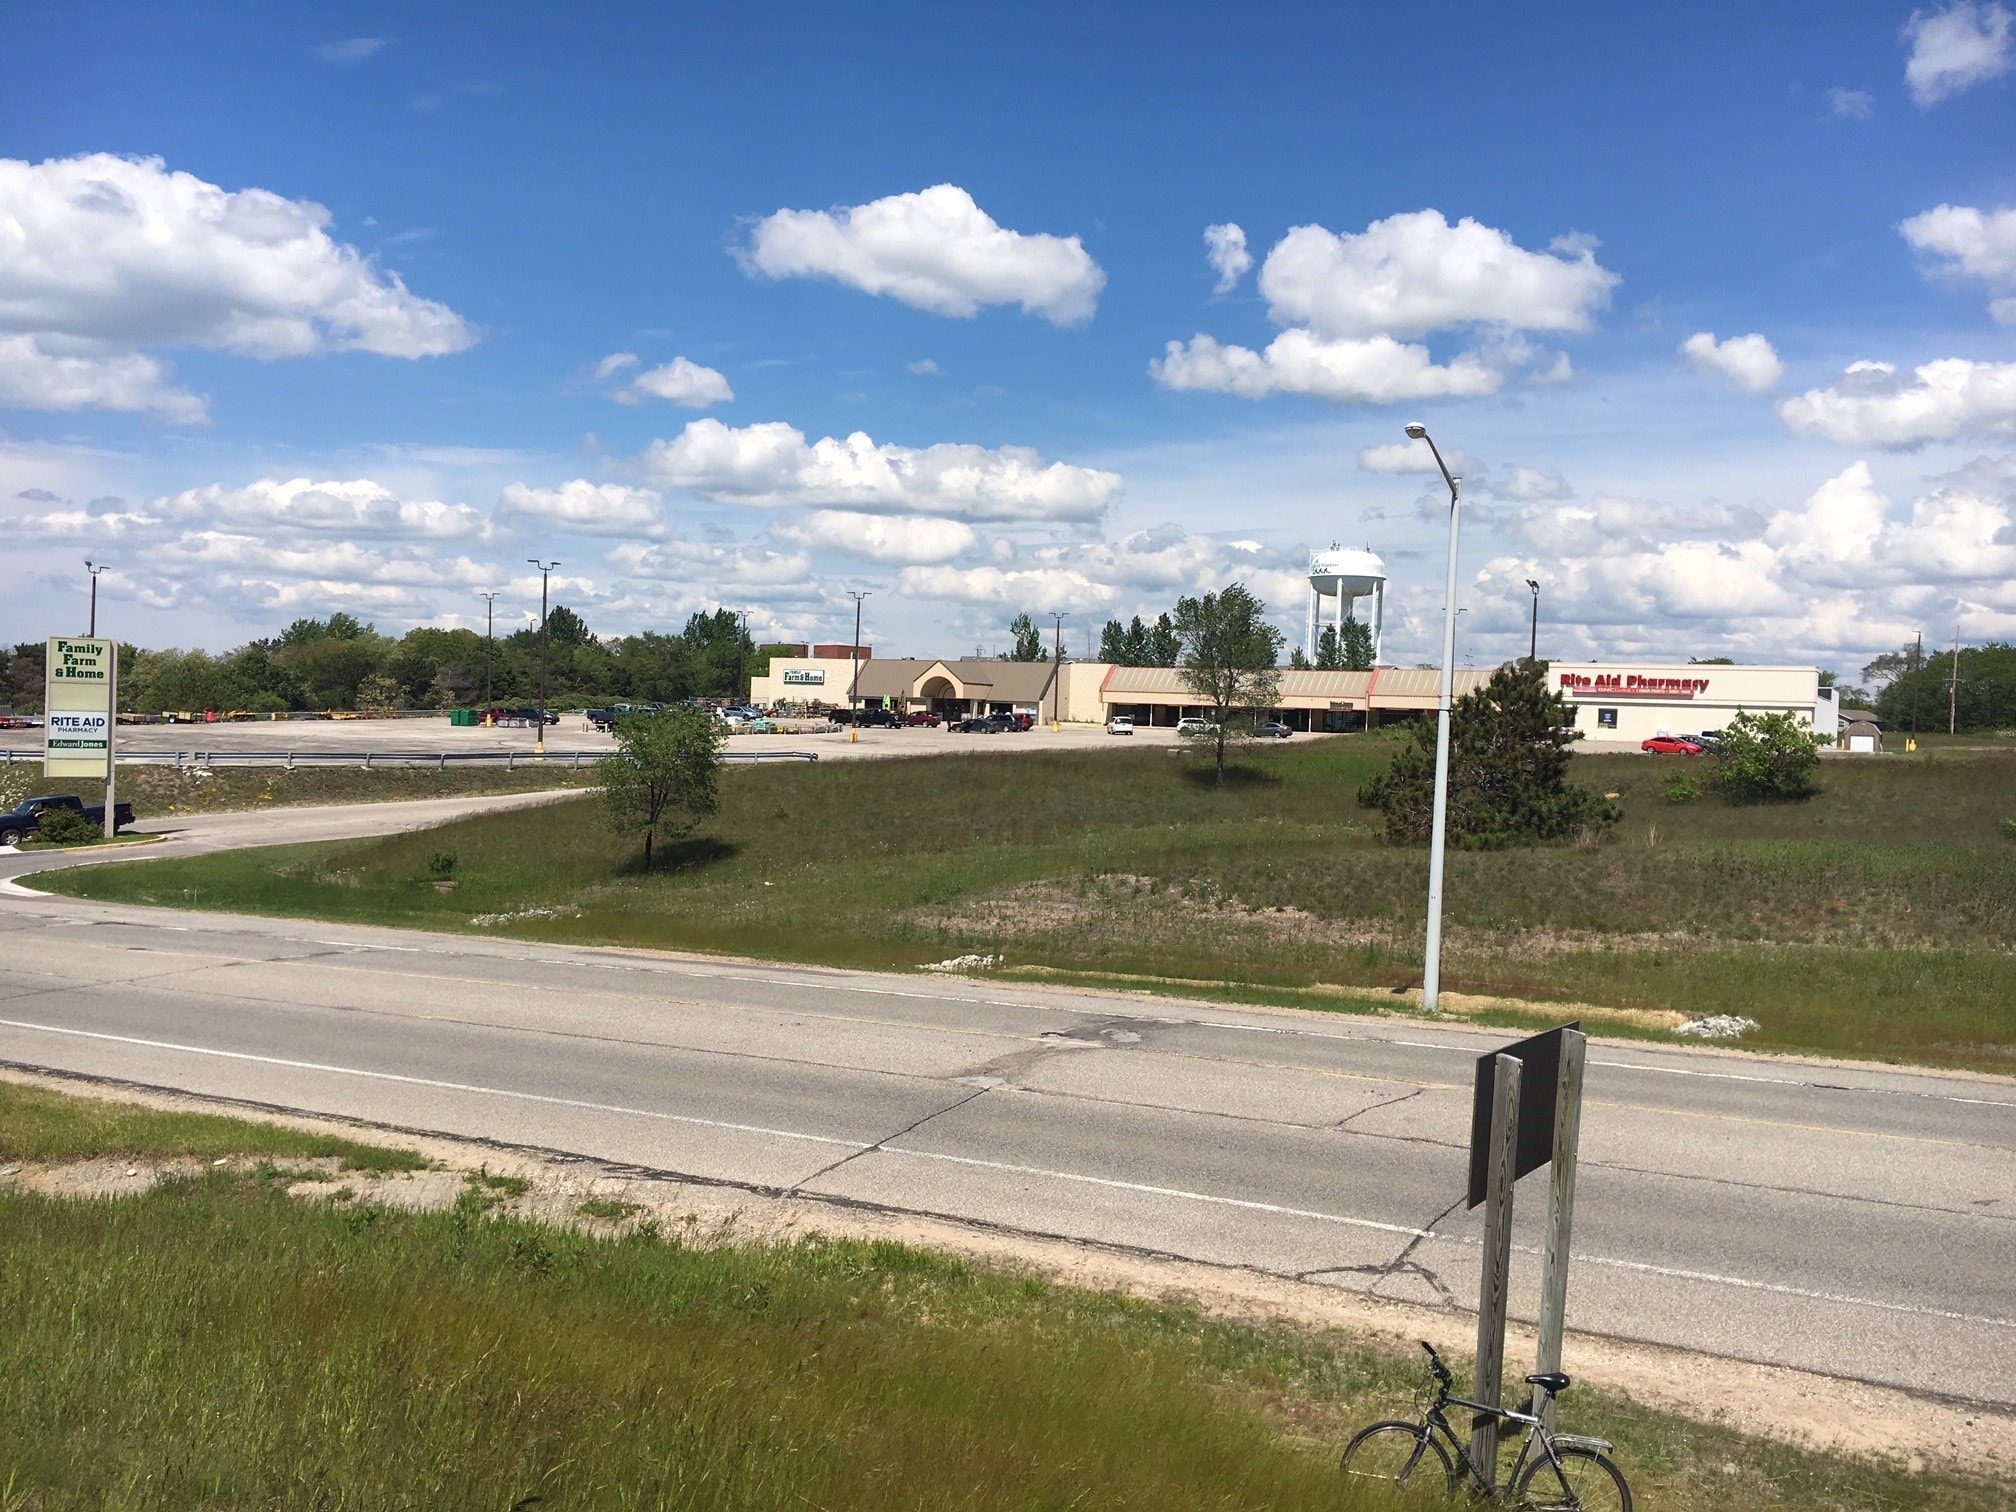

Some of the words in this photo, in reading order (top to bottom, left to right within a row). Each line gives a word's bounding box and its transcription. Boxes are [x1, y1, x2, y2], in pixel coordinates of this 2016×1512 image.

[58, 641, 103, 656] Family
[63, 654, 97, 666] Farm
[55, 668, 63, 677] &
[65, 666, 104, 679] Home
[784, 671, 800, 680] Farm
[805, 672, 822, 681] Home
[1560, 673, 1592, 686] Rite
[1594, 674, 1621, 687] Aid
[1626, 675, 1710, 693] Pharmacy
[51, 716, 80, 726] RITE
[82, 717, 105, 726] AID
[52, 740, 80, 748] Edward
[80, 740, 103, 749] Jones
